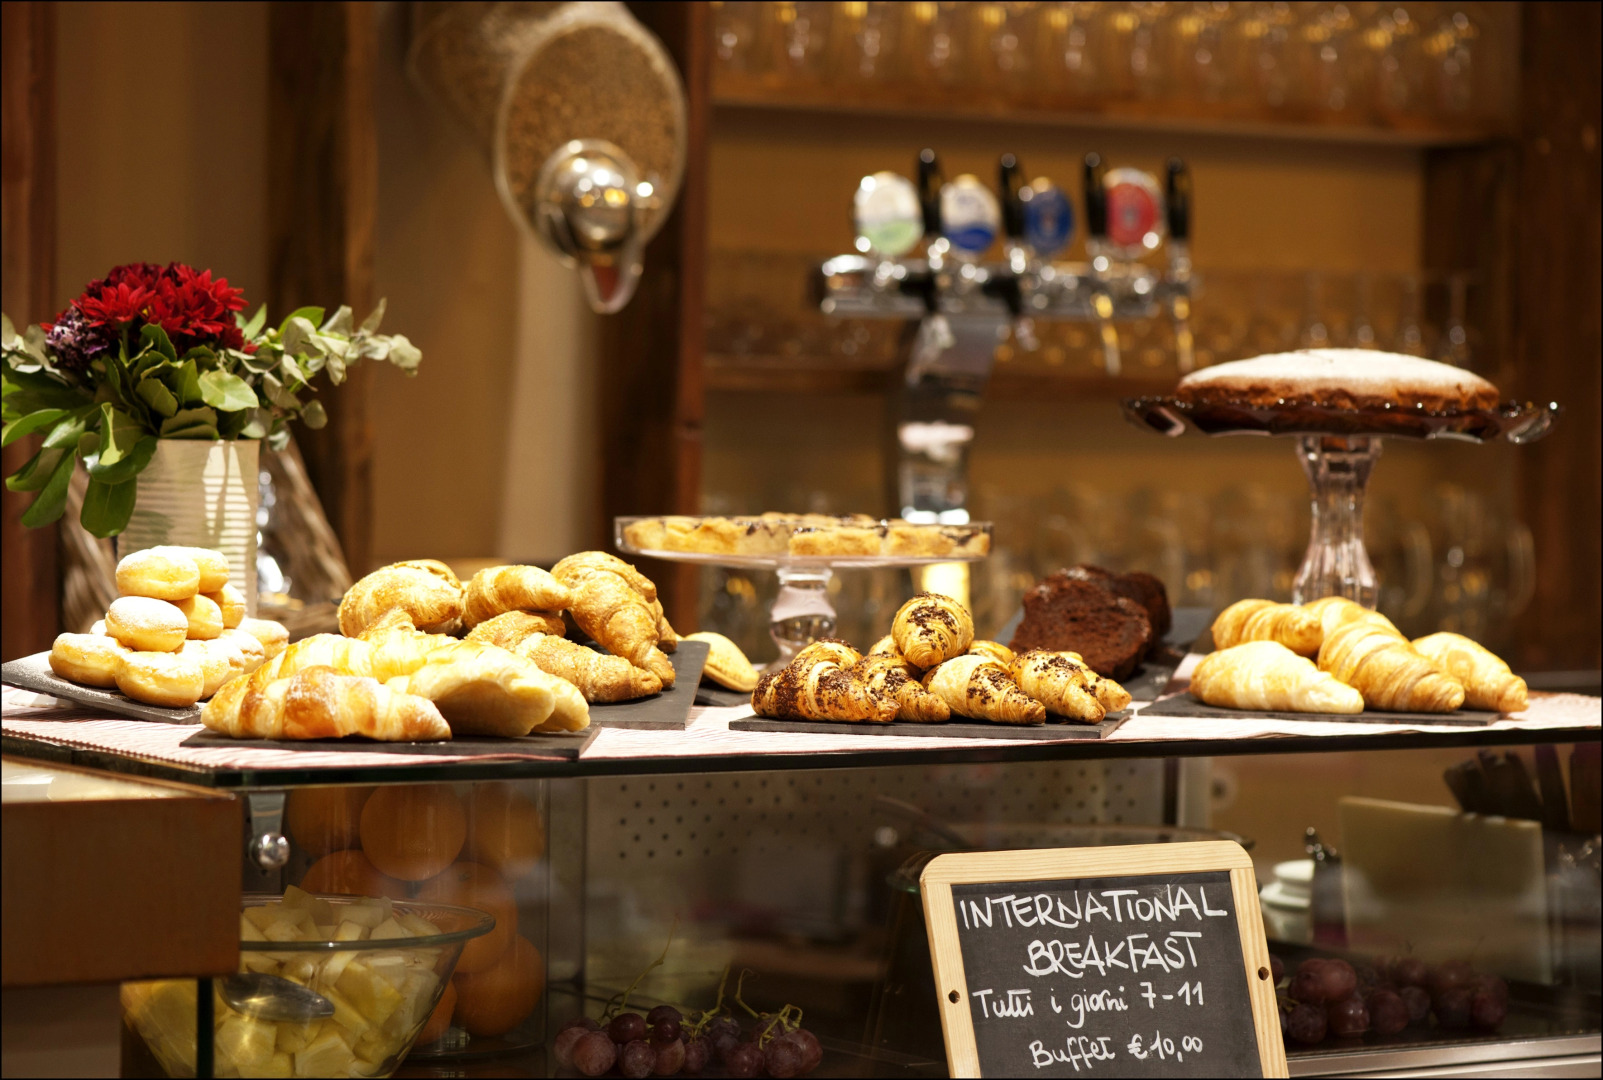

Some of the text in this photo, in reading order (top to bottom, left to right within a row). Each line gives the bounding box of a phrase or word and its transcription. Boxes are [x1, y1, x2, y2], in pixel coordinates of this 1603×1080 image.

[959, 886, 1228, 929] INTERNATIONAL
[1022, 931, 1203, 978] BREAKFAST
[971, 988, 1034, 1018] Tutti
[1050, 987, 1063, 1014] i
[1067, 985, 1129, 1029] giorni
[1028, 1035, 1116, 1072] Buffet
